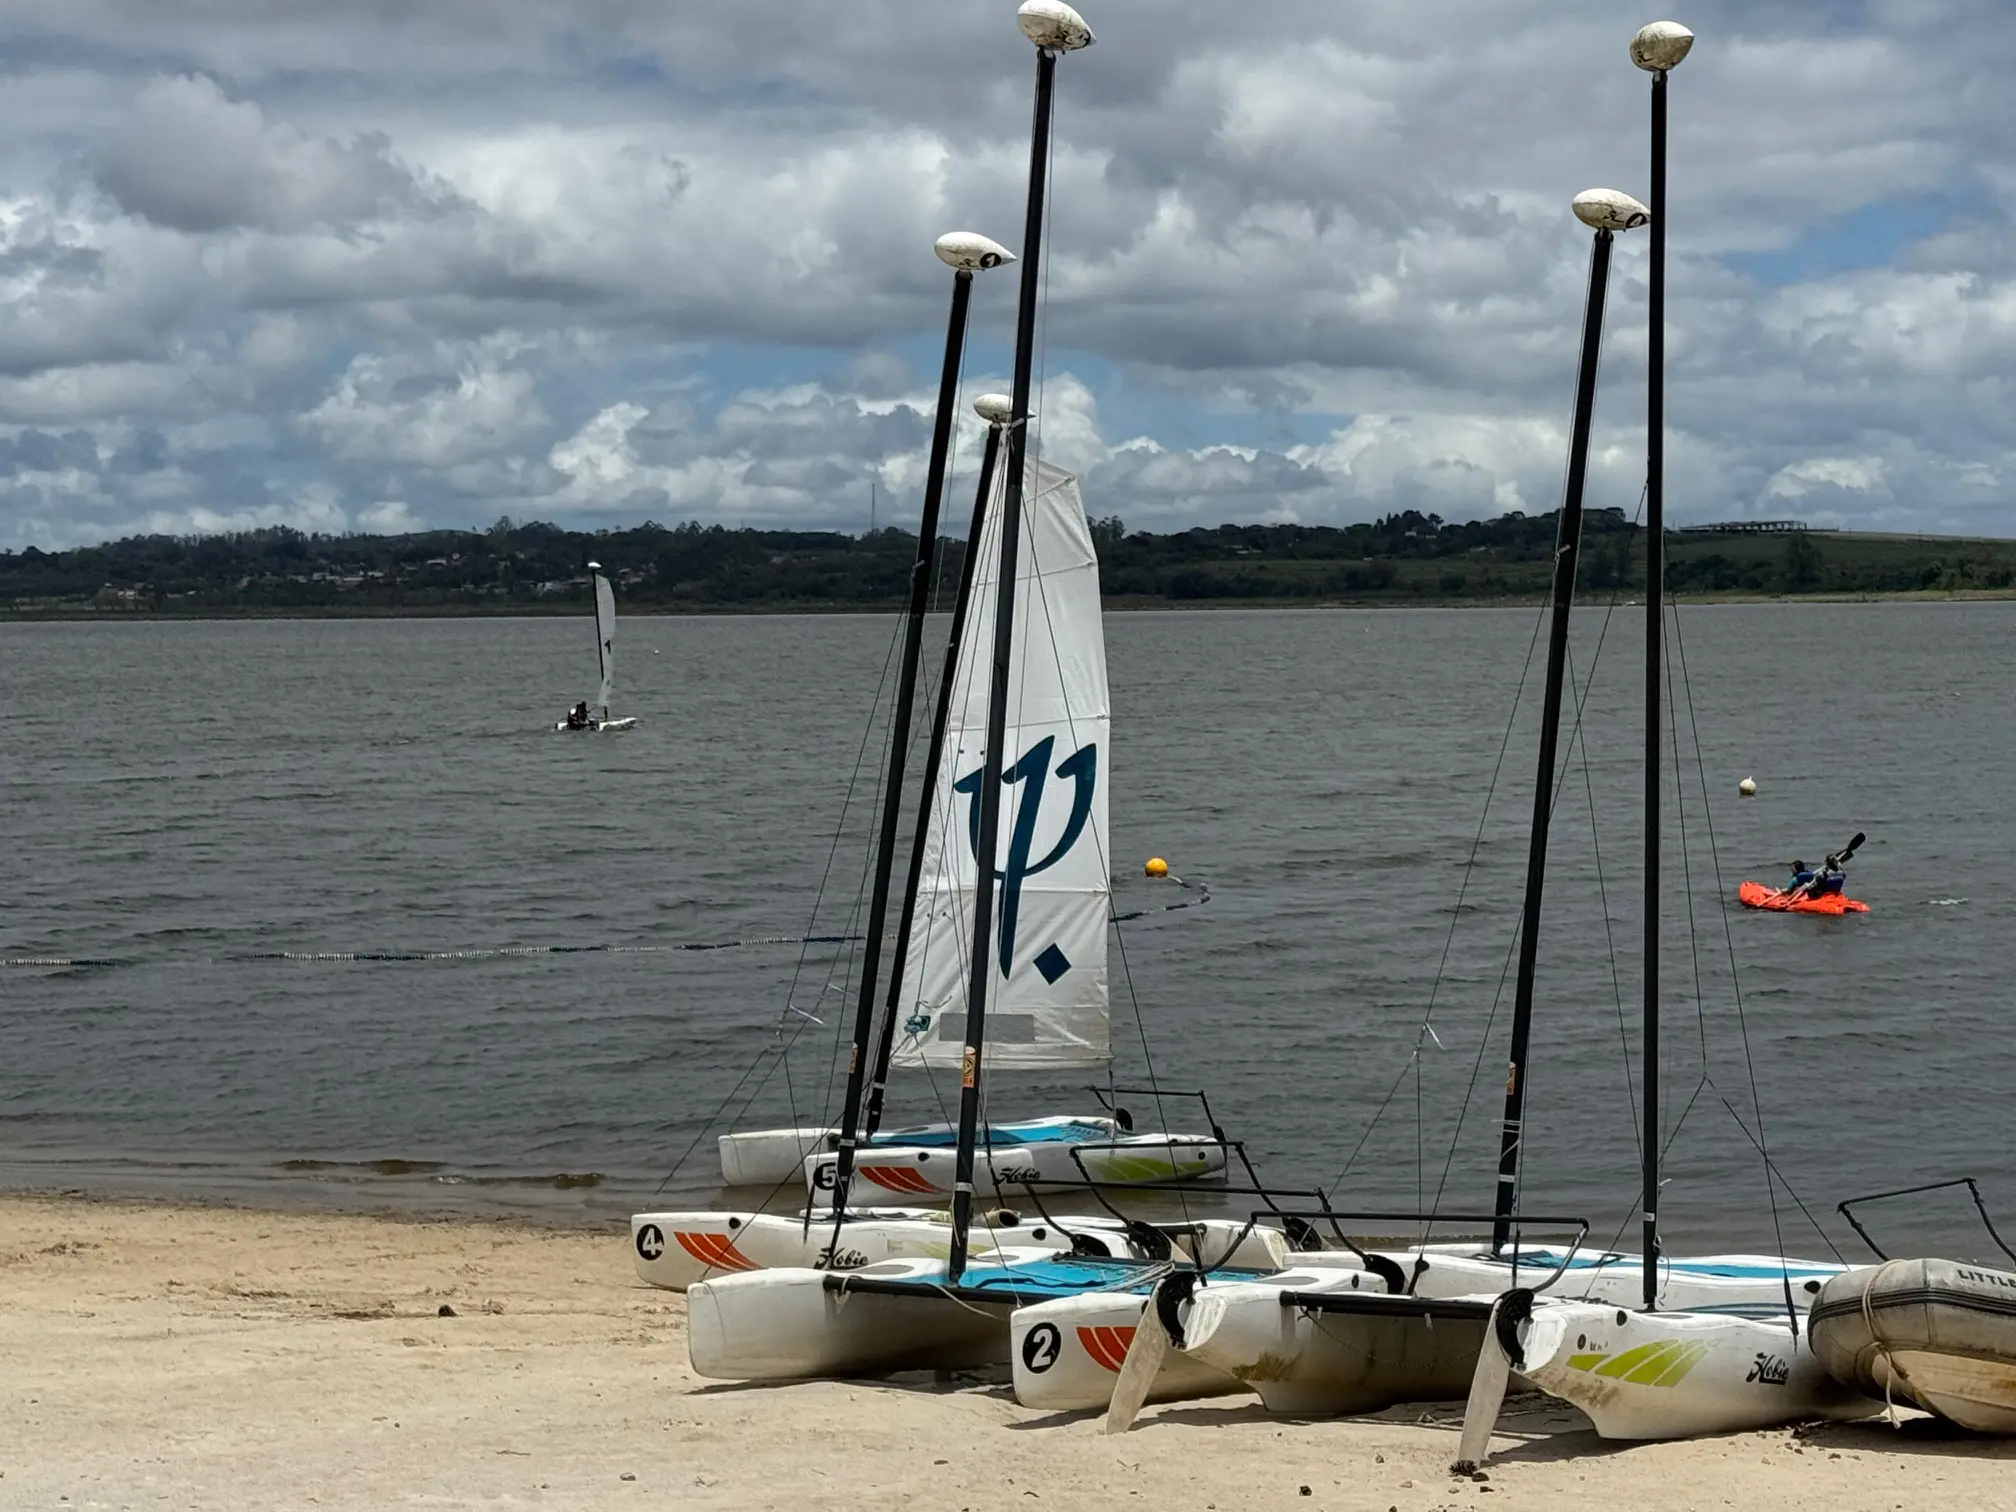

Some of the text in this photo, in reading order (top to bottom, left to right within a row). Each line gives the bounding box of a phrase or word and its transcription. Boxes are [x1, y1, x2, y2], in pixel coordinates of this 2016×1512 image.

[822, 1166, 836, 1187] 5
[642, 1228, 664, 1255] 4
[813, 1247, 869, 1270] Hobie
[1031, 1328, 1053, 1368] 2
[1745, 1352, 1790, 1386] Hobie
